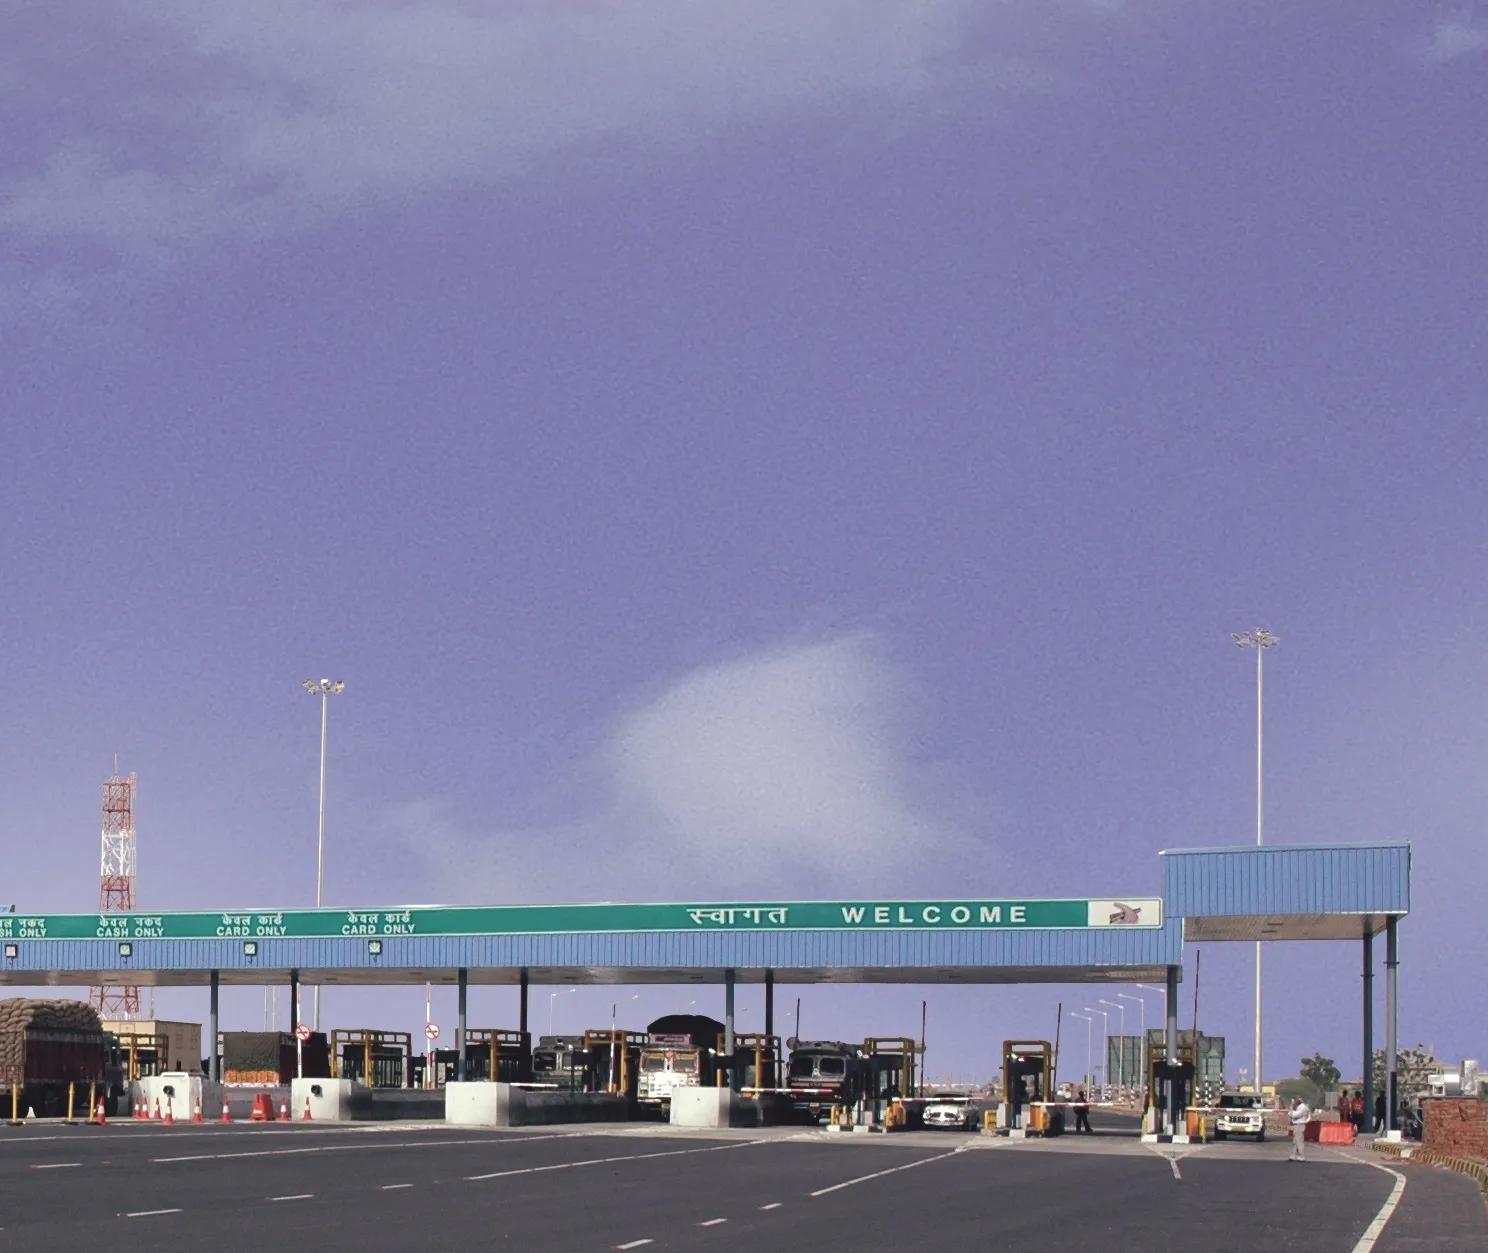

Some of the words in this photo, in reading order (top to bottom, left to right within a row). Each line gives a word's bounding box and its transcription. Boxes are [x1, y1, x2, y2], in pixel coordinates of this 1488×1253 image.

[222, 912, 251, 925] केवल
[256, 912, 283, 925] कार्ड
[346, 911, 379, 923] केवल
[384, 910, 411, 923] कार्ड
[686, 907, 789, 925] स्वागत
[841, 906, 1027, 923] WELCOME
[18, 918, 45, 928] नकद
[99, 915, 127, 927] केवल
[134, 917, 162, 927] नकद
[19, 928, 47, 938] ONLY
[96, 927, 129, 937] CASH
[135, 927, 164, 937] ONLY
[216, 926, 250, 936] CARD
[256, 926, 287, 936] ONLY
[341, 924, 377, 935] CARD
[383, 923, 415, 934] ONLY
